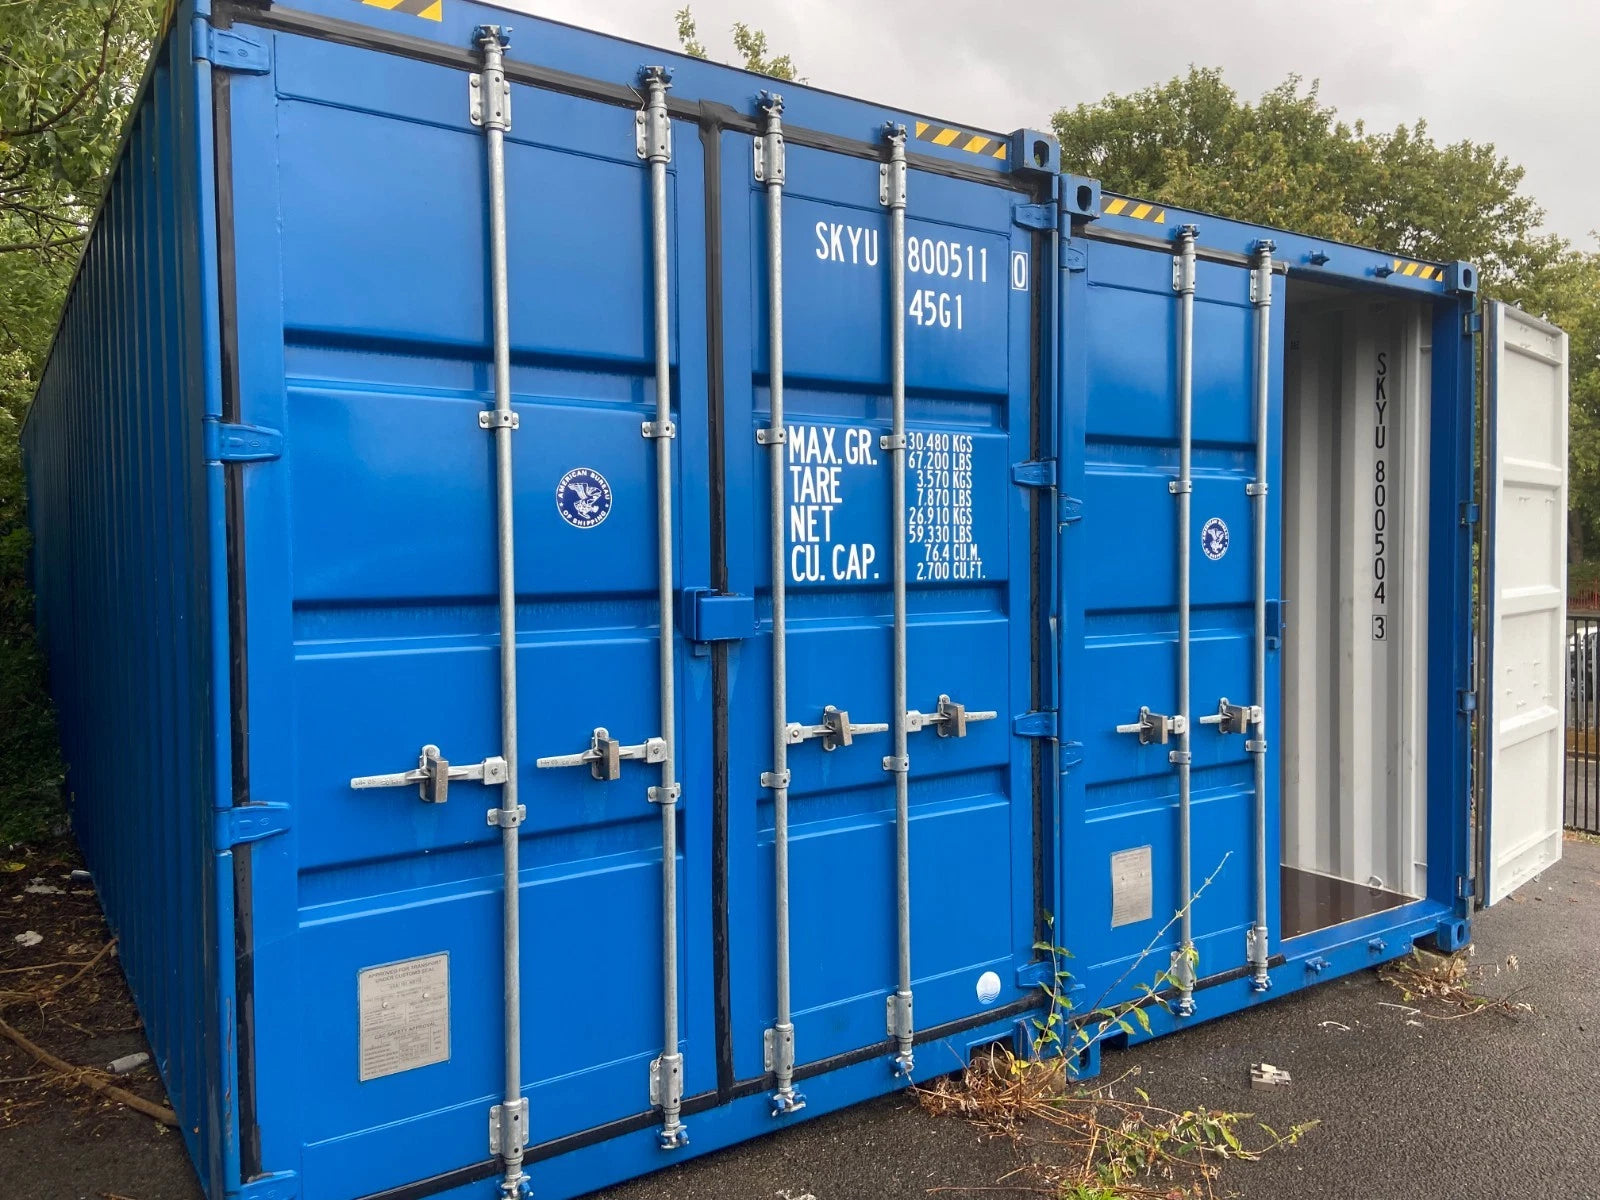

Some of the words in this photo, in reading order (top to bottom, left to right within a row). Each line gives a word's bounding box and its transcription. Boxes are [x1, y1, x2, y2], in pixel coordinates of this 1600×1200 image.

[816, 221, 878, 267] SKYU
[908, 236, 987, 283] 800511
[1014, 254, 1026, 288] 0
[909, 289, 962, 330] 45G1
[1374, 352, 1387, 449] SKYU
[789, 425, 843, 464] MAX.
[845, 428, 878, 465] GR.
[908, 432, 949, 451] 30,480
[952, 434, 973, 452] KGS
[908, 452, 949, 470] 67,200
[952, 453, 972, 471] LBS
[558, 470, 587, 498] AMERICAN
[590, 472, 610, 499] BUREAU
[790, 466, 842, 503] TARE
[916, 470, 949, 488] 3,570
[952, 471, 972, 489] KGS
[917, 488, 949, 506] 7,870
[952, 489, 972, 507] LBS
[573, 510, 606, 526] SHIPPING
[791, 505, 834, 542] NET
[909, 507, 949, 525] 26,910
[952, 507, 972, 525] KGS
[909, 525, 949, 543] 59,330
[952, 525, 972, 543] LBS
[1374, 460, 1386, 604] 800504
[792, 544, 826, 582] CU.
[832, 543, 879, 580] CAP.
[925, 544, 949, 562] 76.4
[916, 562, 949, 580] 2,700
[1374, 616, 1385, 639] 3
